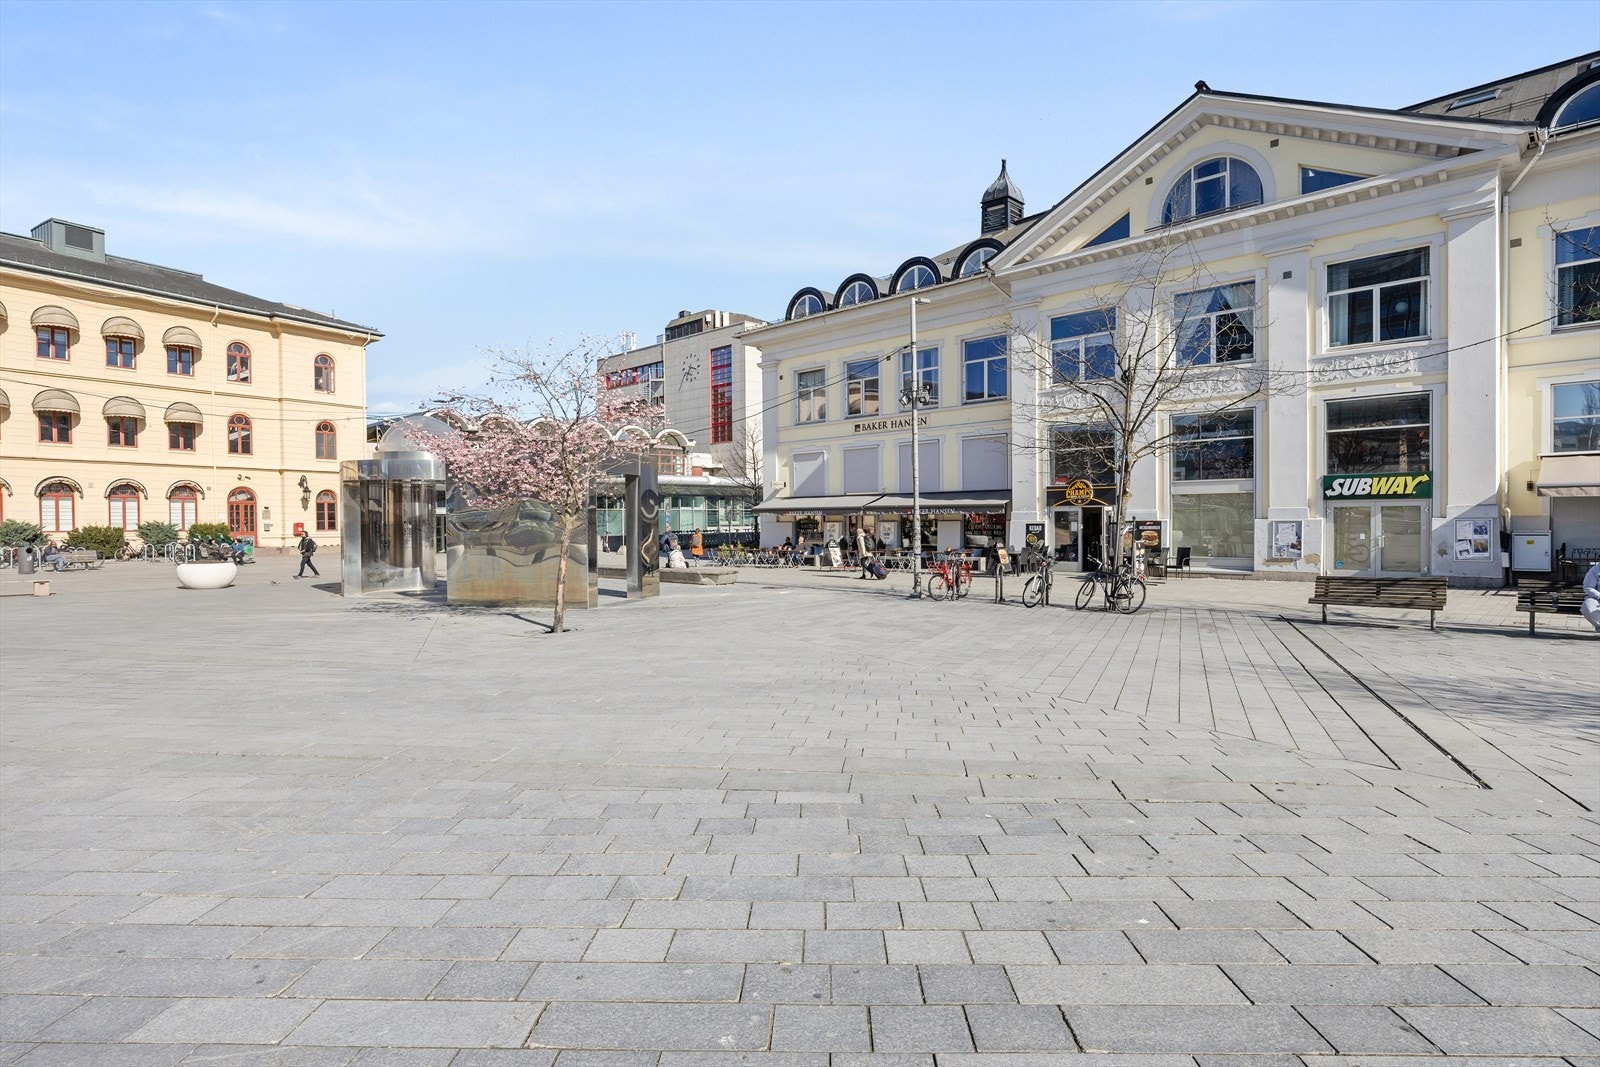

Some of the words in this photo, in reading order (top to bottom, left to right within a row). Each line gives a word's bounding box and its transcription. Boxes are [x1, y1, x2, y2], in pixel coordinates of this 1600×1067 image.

[861, 421, 888, 431] BAKER
[891, 417, 927, 428] HANEN
[1325, 474, 1430, 497] SUBWAY
